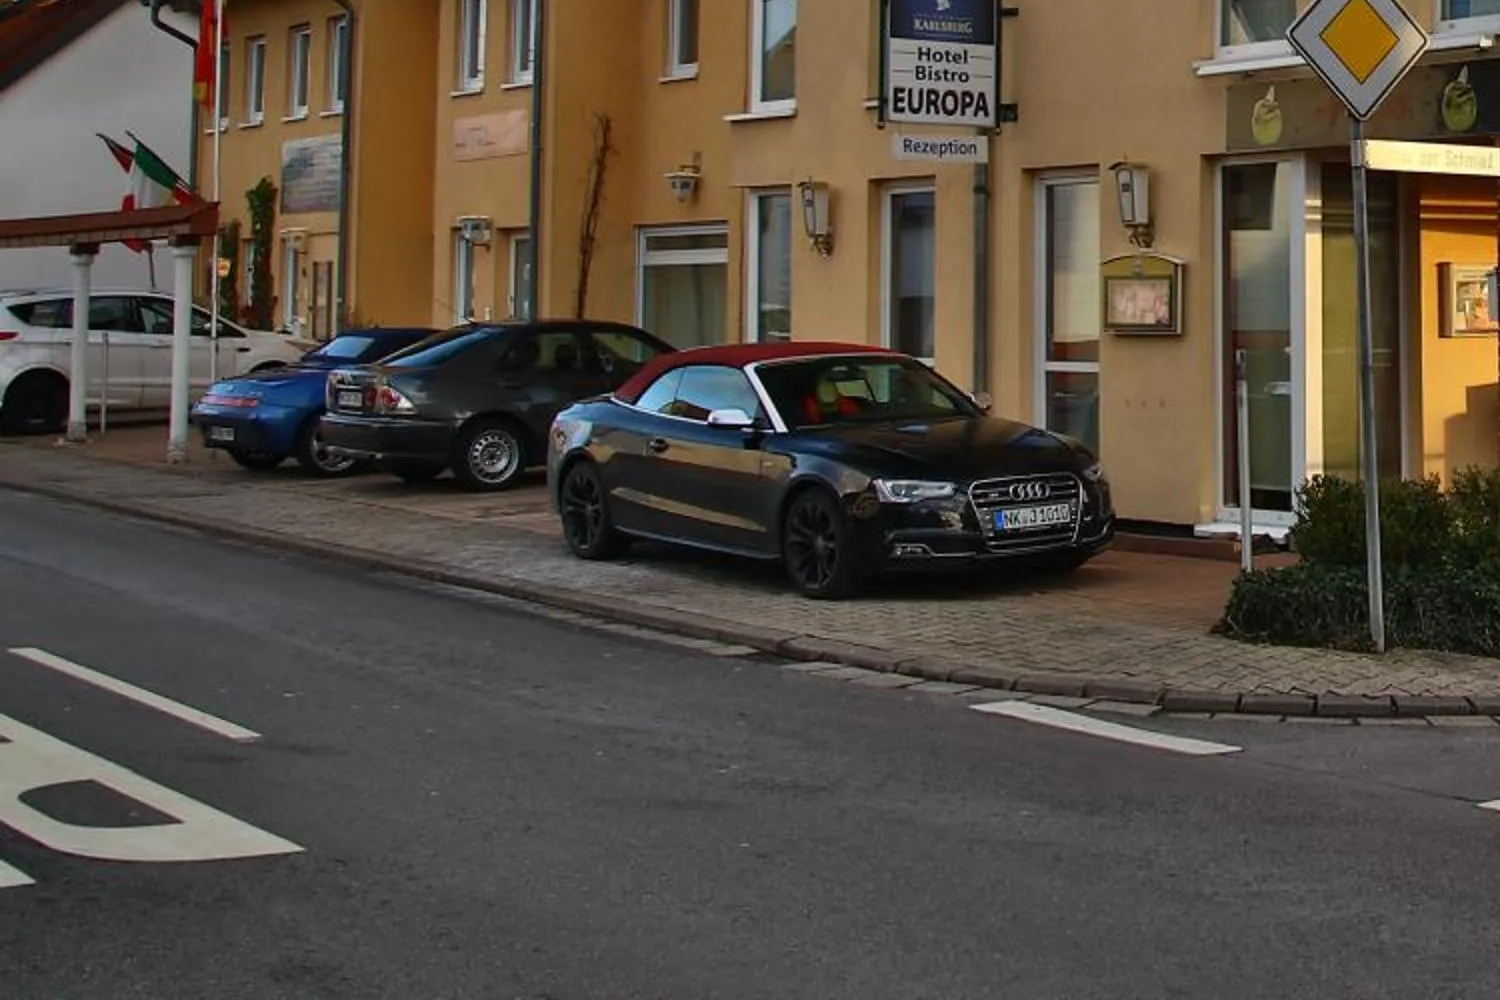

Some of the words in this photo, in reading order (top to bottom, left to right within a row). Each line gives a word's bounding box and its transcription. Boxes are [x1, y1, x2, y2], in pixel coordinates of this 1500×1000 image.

[917, 46, 969, 65] Hotel
[915, 66, 970, 83] Bistro
[891, 87, 989, 118] EUROPA
[903, 138, 977, 158] Rezeption
